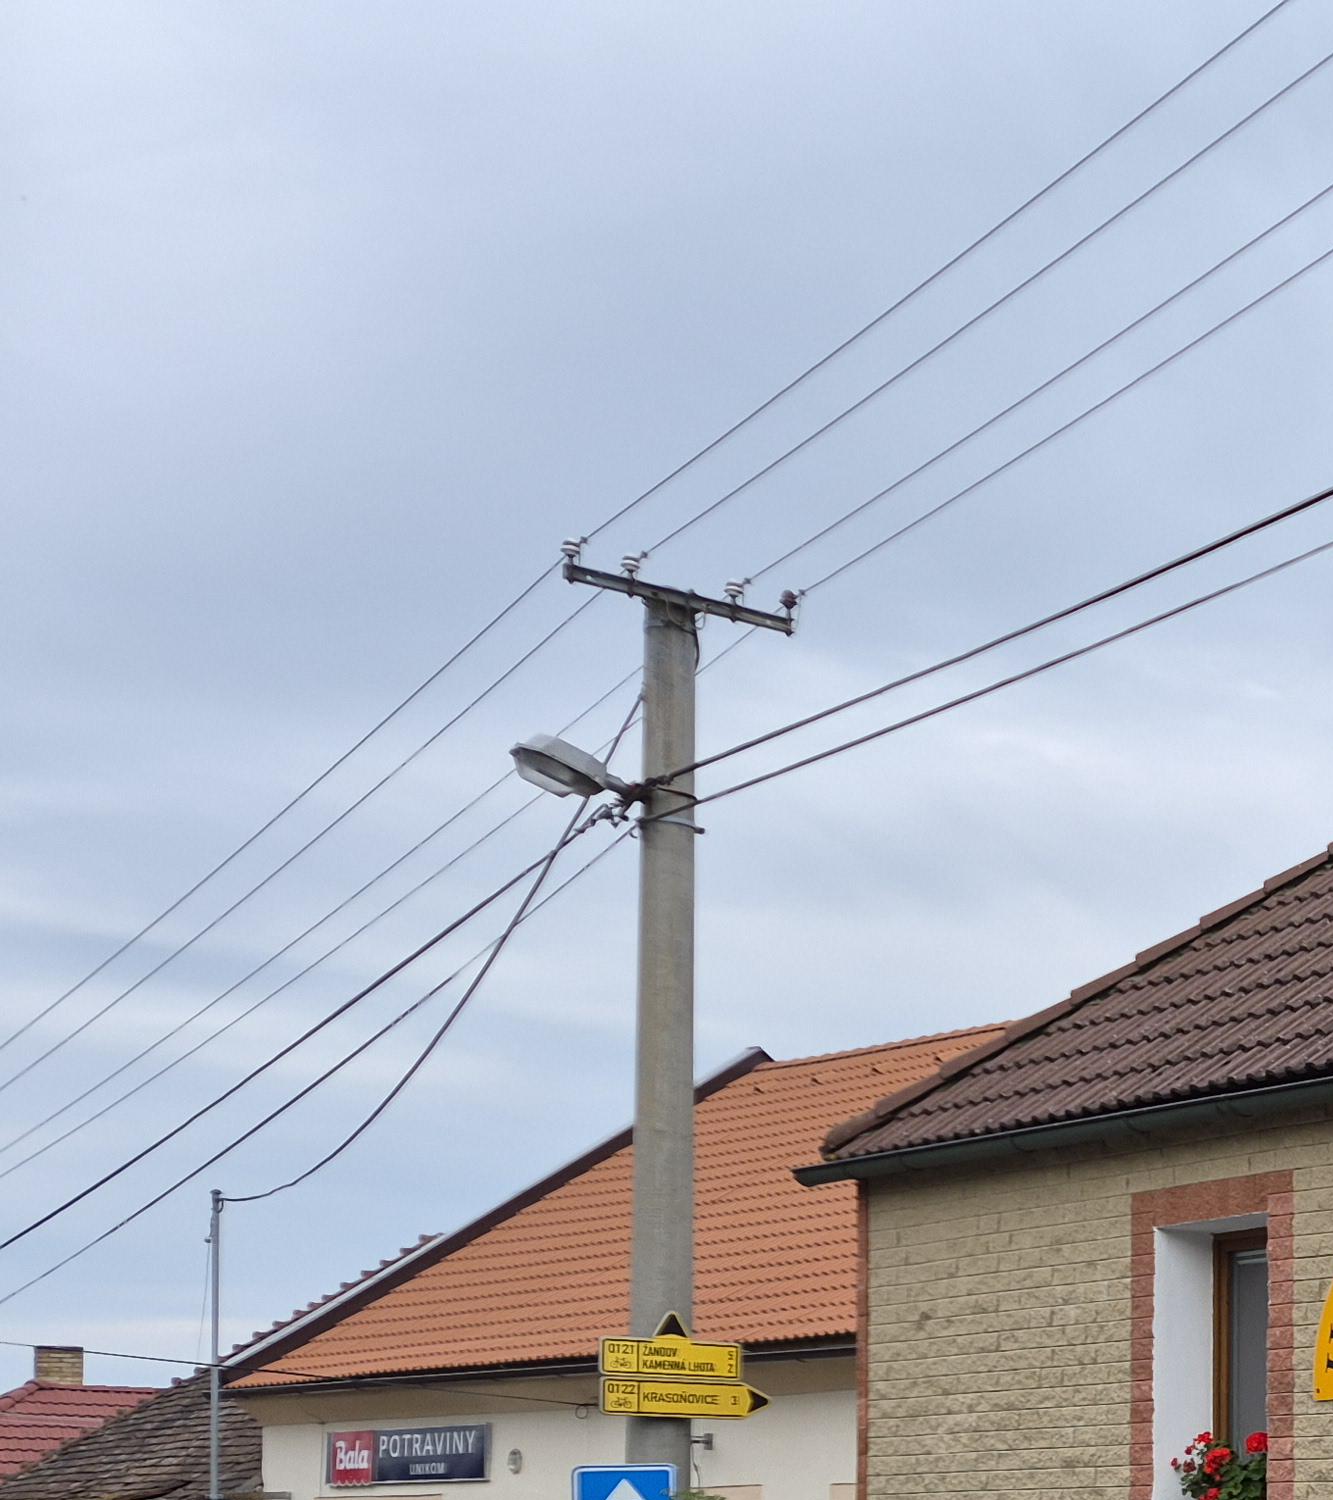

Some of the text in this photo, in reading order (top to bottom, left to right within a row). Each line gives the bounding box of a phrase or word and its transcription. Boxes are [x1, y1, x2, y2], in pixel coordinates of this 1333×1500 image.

[608, 1343, 634, 1354] 0121
[642, 1346, 678, 1357] ŽANDOV
[642, 1359, 686, 1371] KAMENNÁ
[688, 1362, 715, 1373] LHOTA
[607, 1384, 636, 1395] 0122
[642, 1391, 720, 1405] KRASOŇOVICE
[378, 1430, 477, 1458] POTRAVINY
[335, 1440, 369, 1471] Bala
[409, 1463, 446, 1475] UNIKOM
